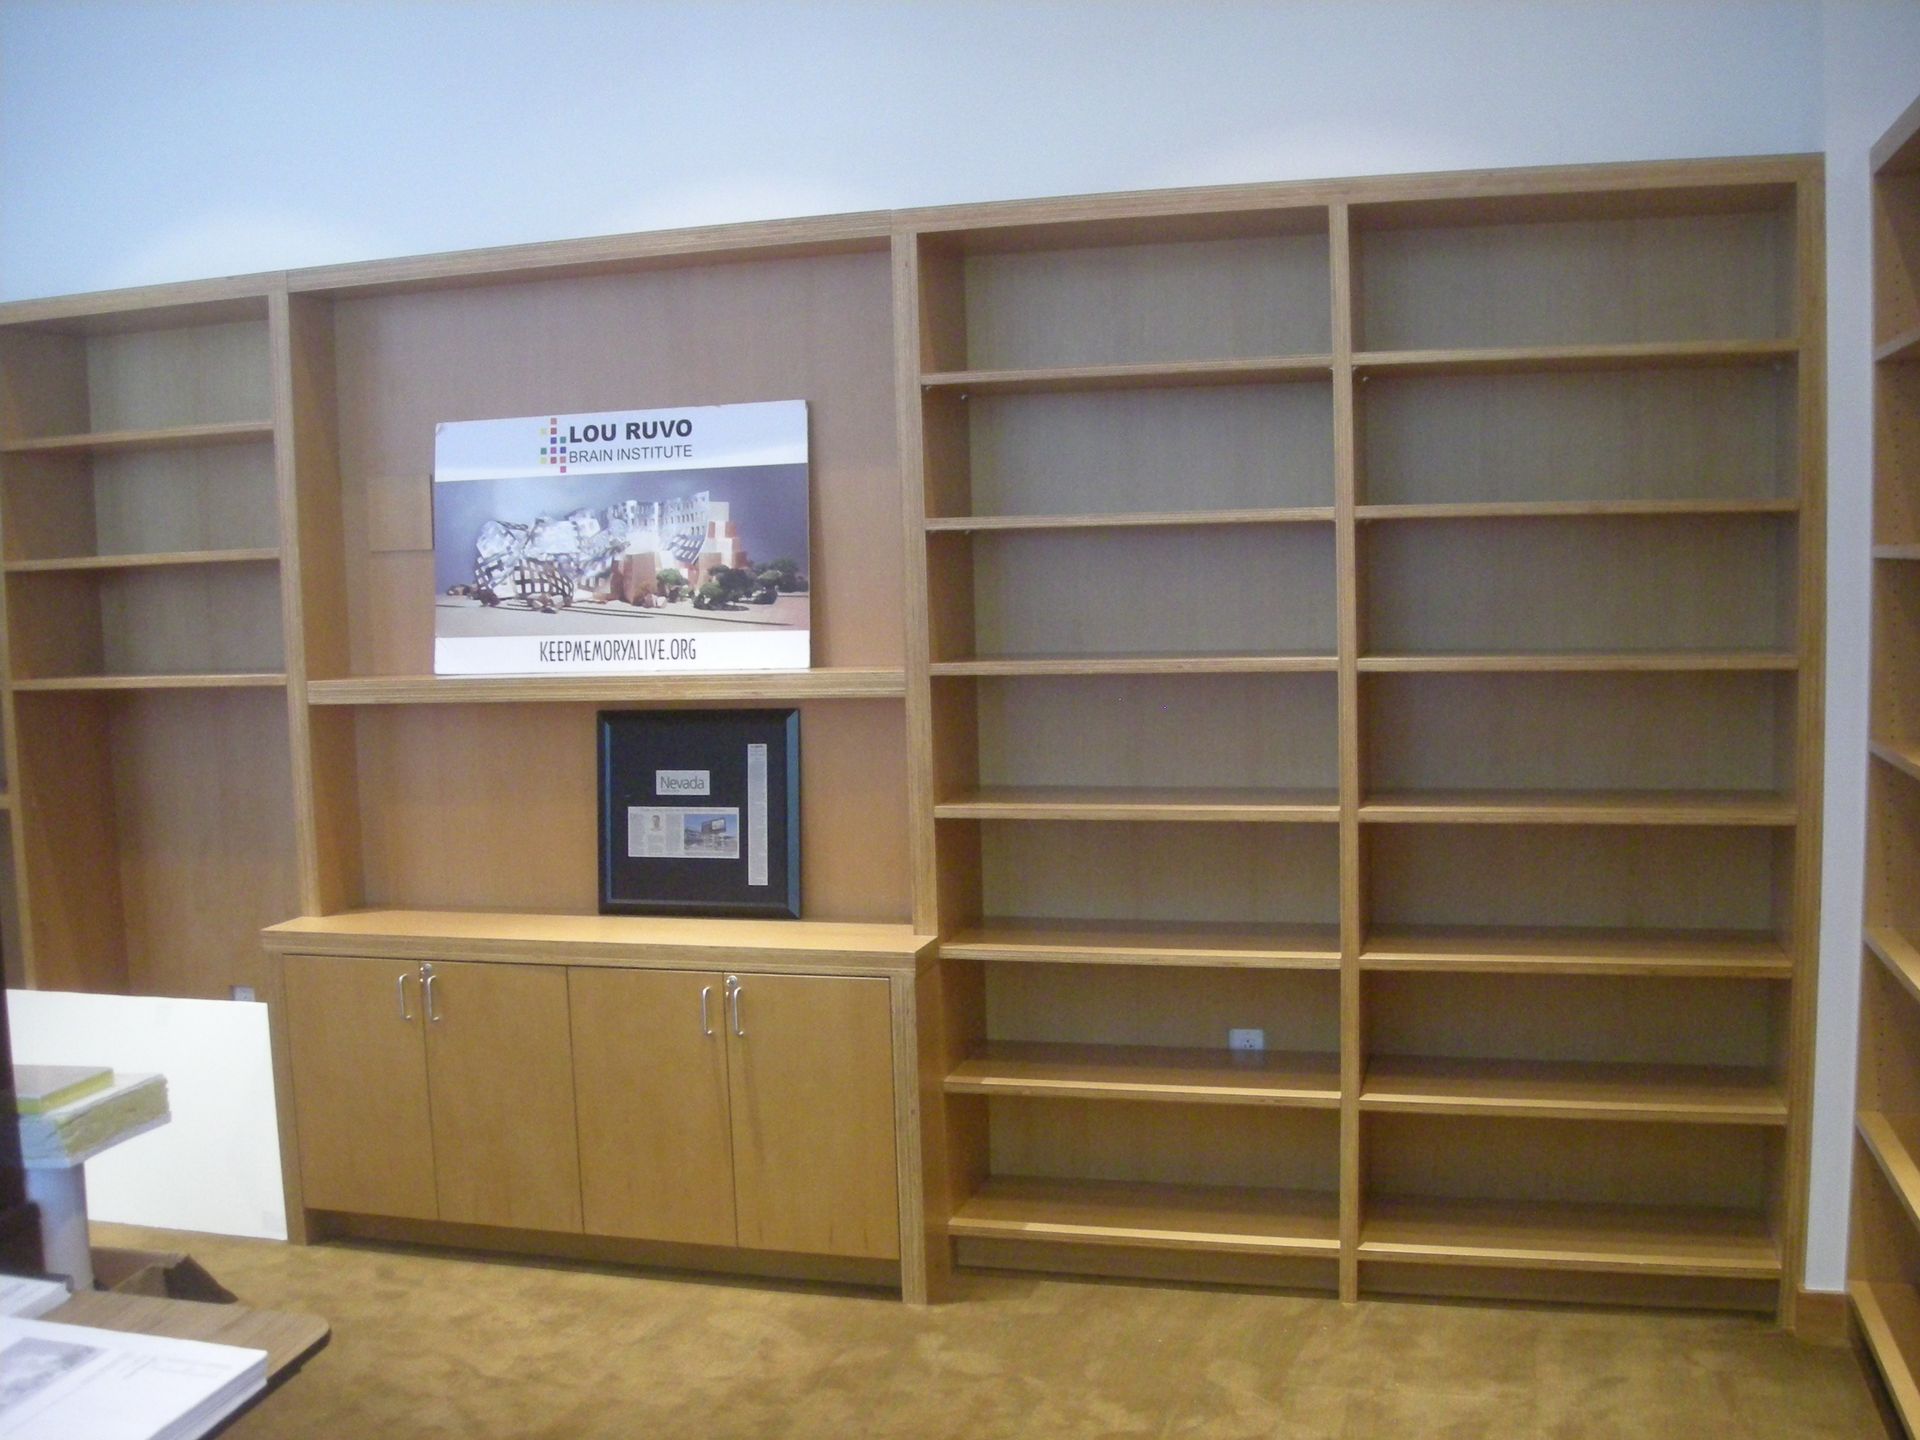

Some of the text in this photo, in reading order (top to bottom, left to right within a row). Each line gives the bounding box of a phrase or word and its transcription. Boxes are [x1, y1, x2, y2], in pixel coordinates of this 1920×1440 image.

[569, 419, 693, 443] LOU RUVO
[569, 444, 693, 464] BRAIN INSTITUTE
[539, 638, 697, 662] KEEPMEMORYALIVE.ORG
[660, 775, 705, 790] Nevada
